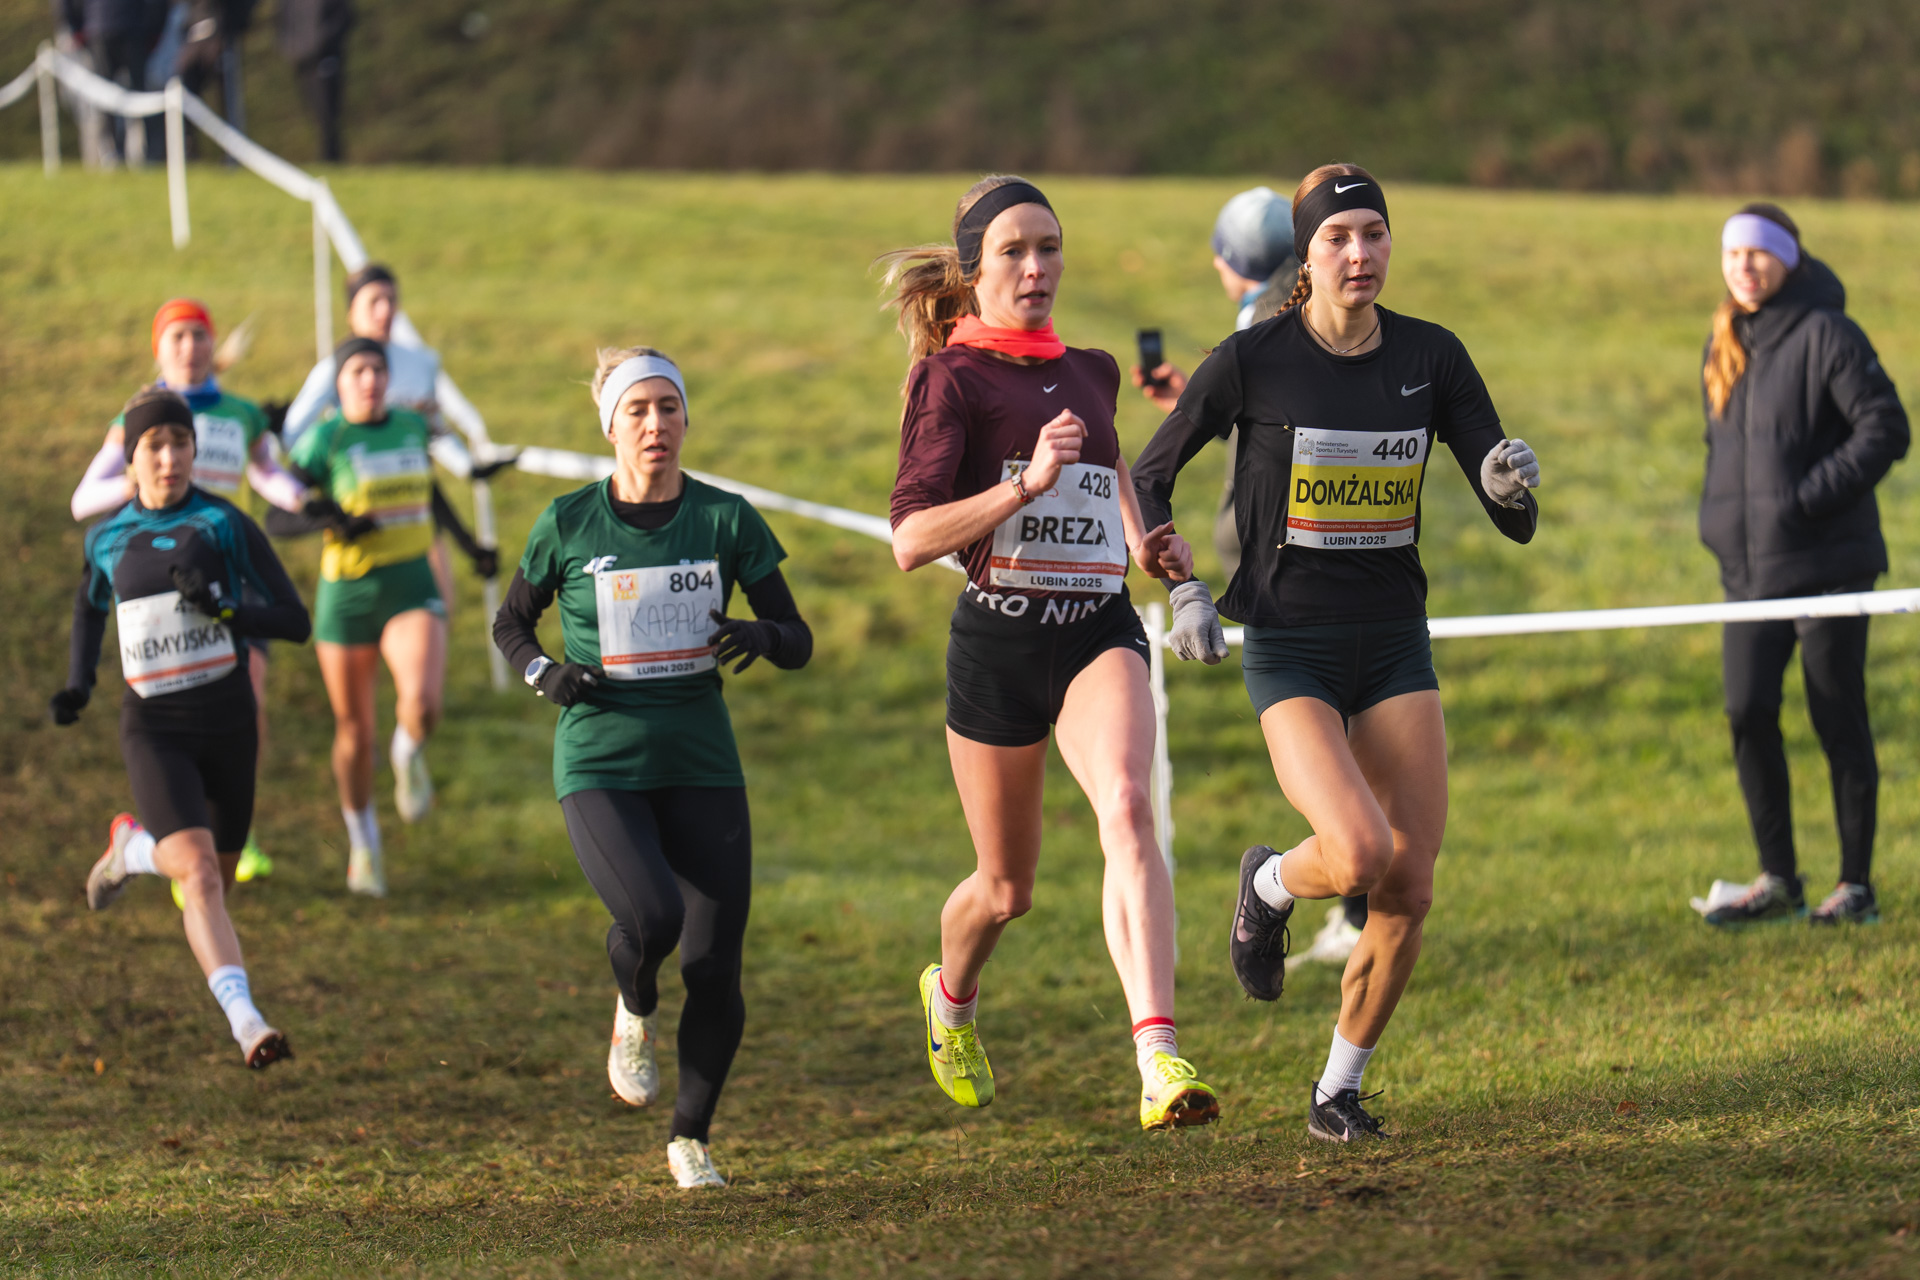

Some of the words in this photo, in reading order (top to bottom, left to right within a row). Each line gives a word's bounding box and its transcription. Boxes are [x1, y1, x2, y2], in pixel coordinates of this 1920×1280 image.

[1372, 437, 1419, 461] 440
[1078, 471, 1112, 500] 428
[1295, 473, 1414, 506] DOMŻALSKA
[1323, 536, 1357, 546] LUBIN
[1359, 535, 1387, 546] 2025
[669, 569, 714, 593] 804
[1030, 575, 1069, 587] LUBIN
[1071, 577, 1103, 588] 2025
[125, 624, 227, 663] NIEMYJSKA
[637, 664, 669, 675] LUBIN
[670, 661, 696, 672] 2025
